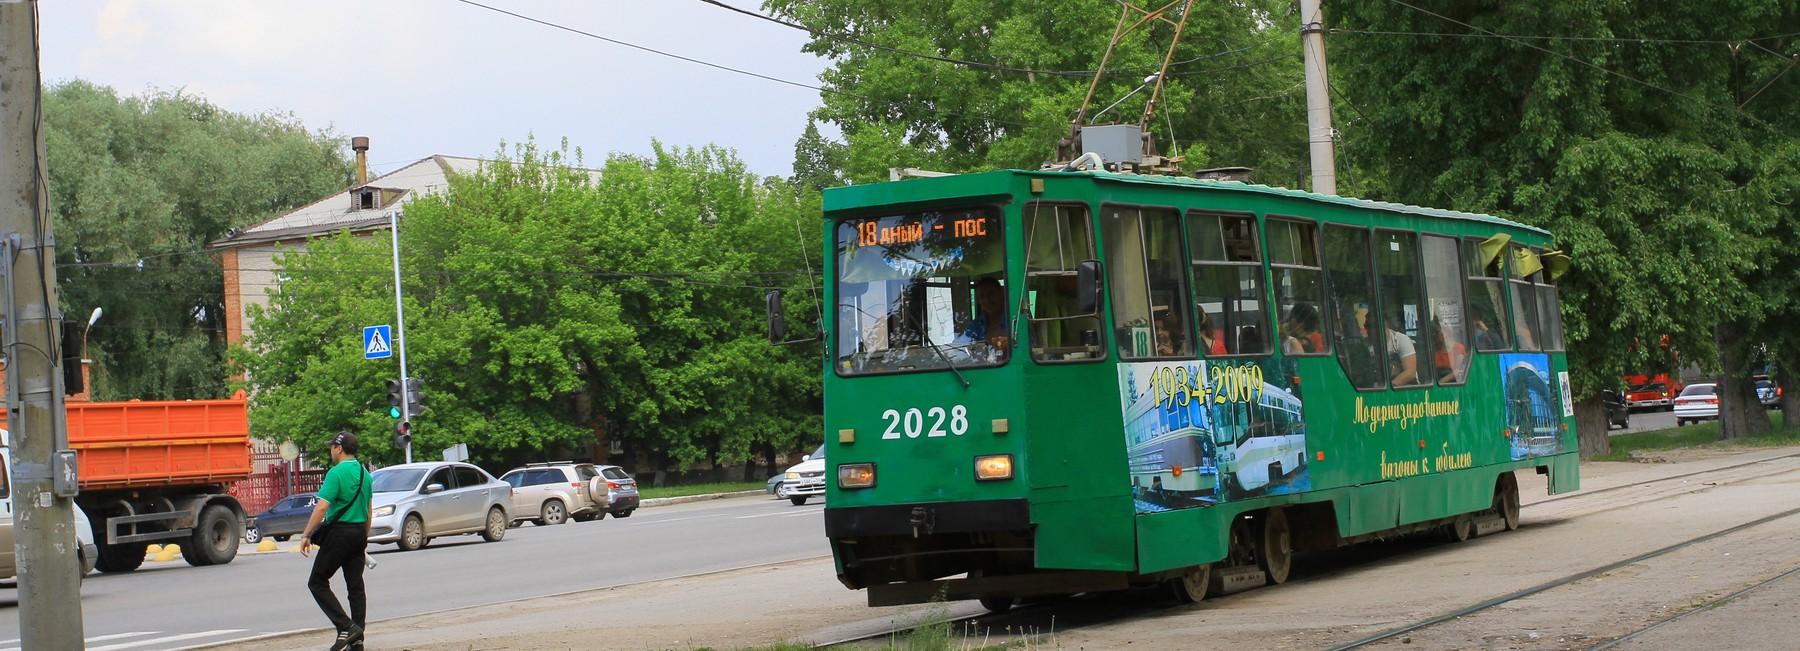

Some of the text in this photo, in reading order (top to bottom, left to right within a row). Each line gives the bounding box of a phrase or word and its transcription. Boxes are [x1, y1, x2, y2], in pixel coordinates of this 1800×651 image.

[857, 222, 878, 247] 18
[1135, 331, 1148, 357] 18
[1149, 364, 1264, 410] 1934-2009
[881, 404, 969, 440] 2028
[1353, 390, 1460, 433] Модернизированные
[1380, 441, 1473, 480] вагоны к юбилею
